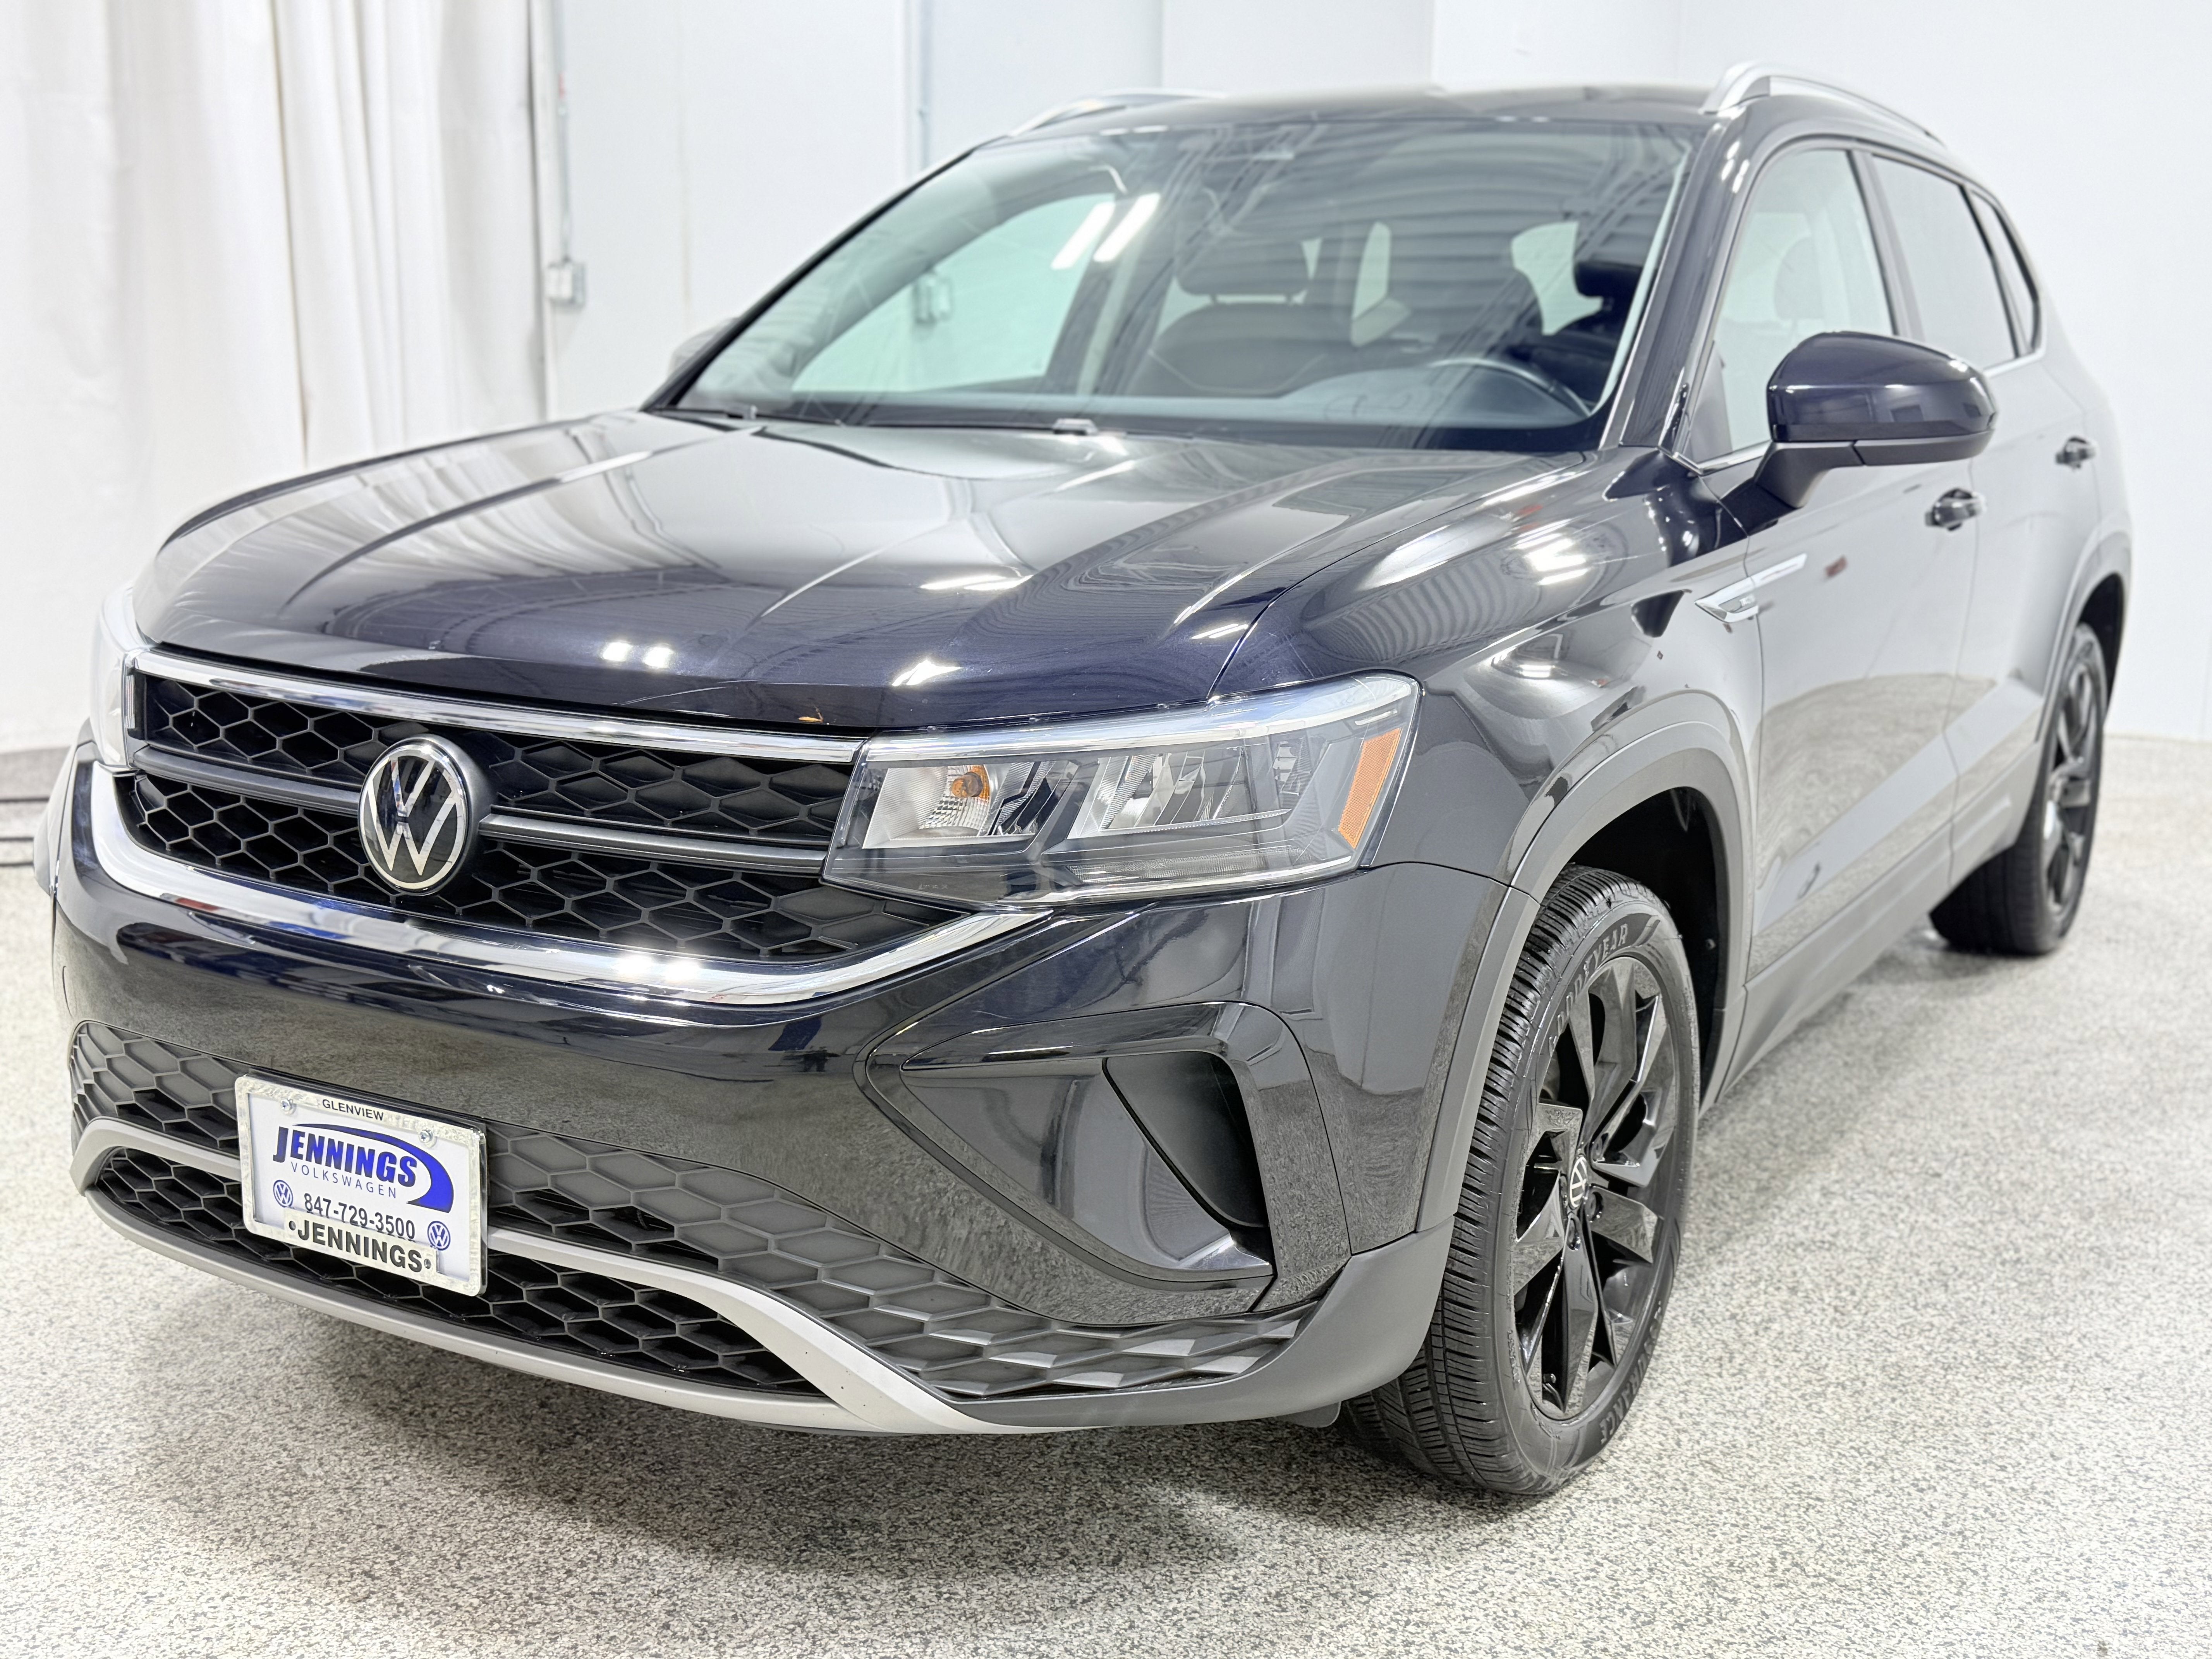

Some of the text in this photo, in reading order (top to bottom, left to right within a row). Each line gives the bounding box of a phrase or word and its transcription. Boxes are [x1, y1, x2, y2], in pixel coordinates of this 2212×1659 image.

[322, 1099, 384, 1121] GLENVIEW
[273, 1126, 417, 1187] JENNINGS
[291, 1161, 396, 1198] VOLKSWAGEN
[304, 1193, 415, 1239] 847-729-3500
[297, 1220, 422, 1273] JENNINGS
